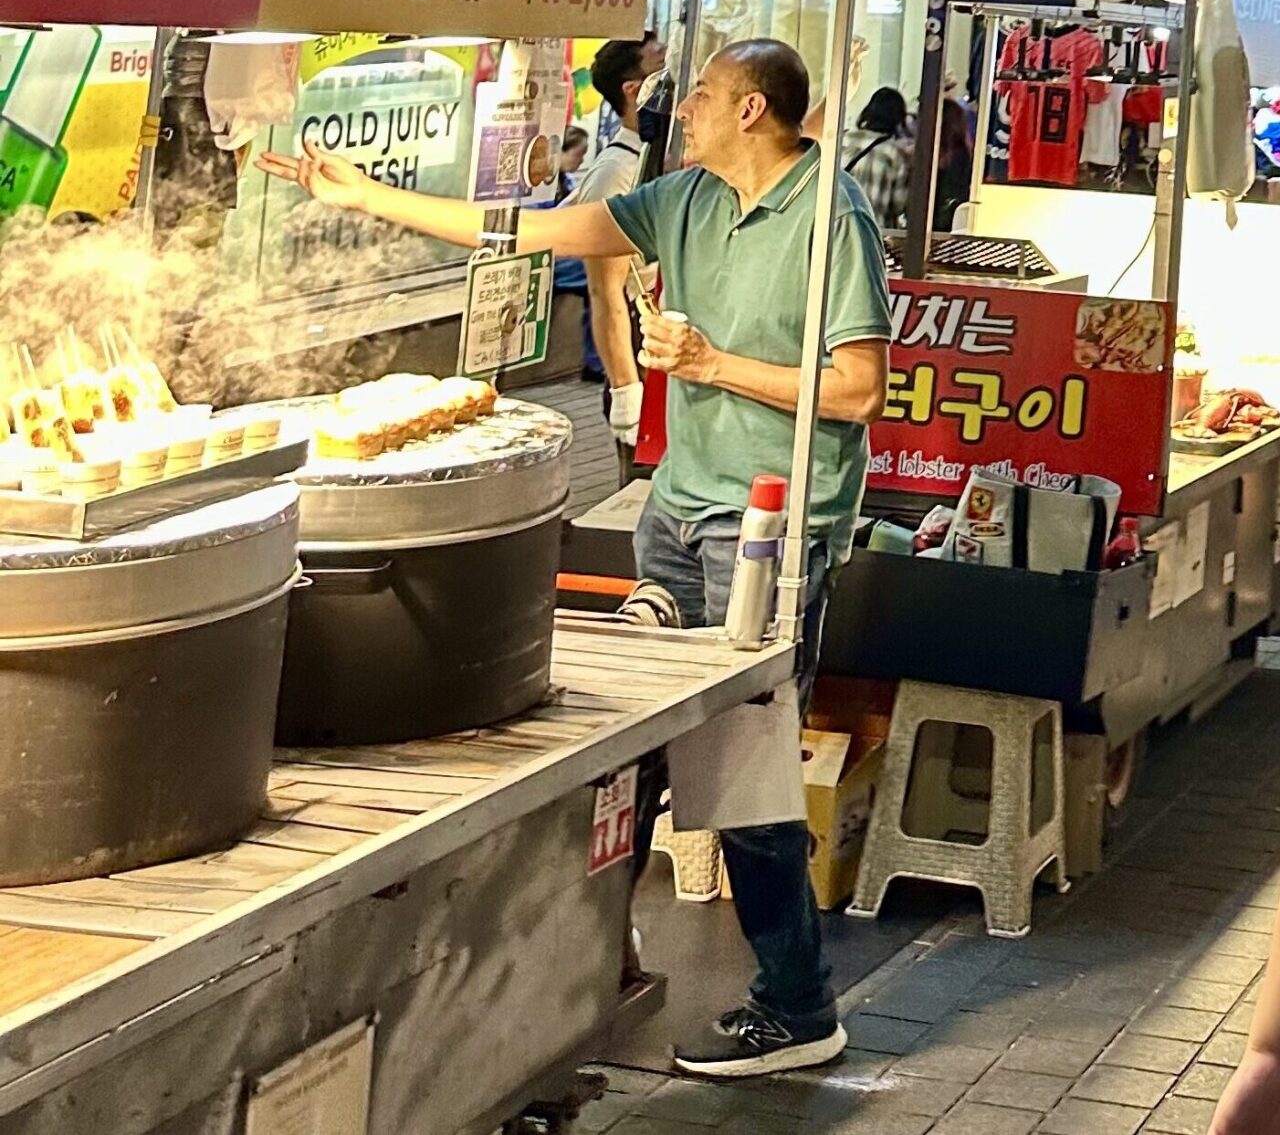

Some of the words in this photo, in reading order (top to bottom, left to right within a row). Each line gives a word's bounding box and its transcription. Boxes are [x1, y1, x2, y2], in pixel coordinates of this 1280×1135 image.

[302, 111, 377, 152] COLD
[382, 102, 459, 155] JUICY
[1026, 84, 1071, 144] 18
[898, 450, 965, 481] lobster
